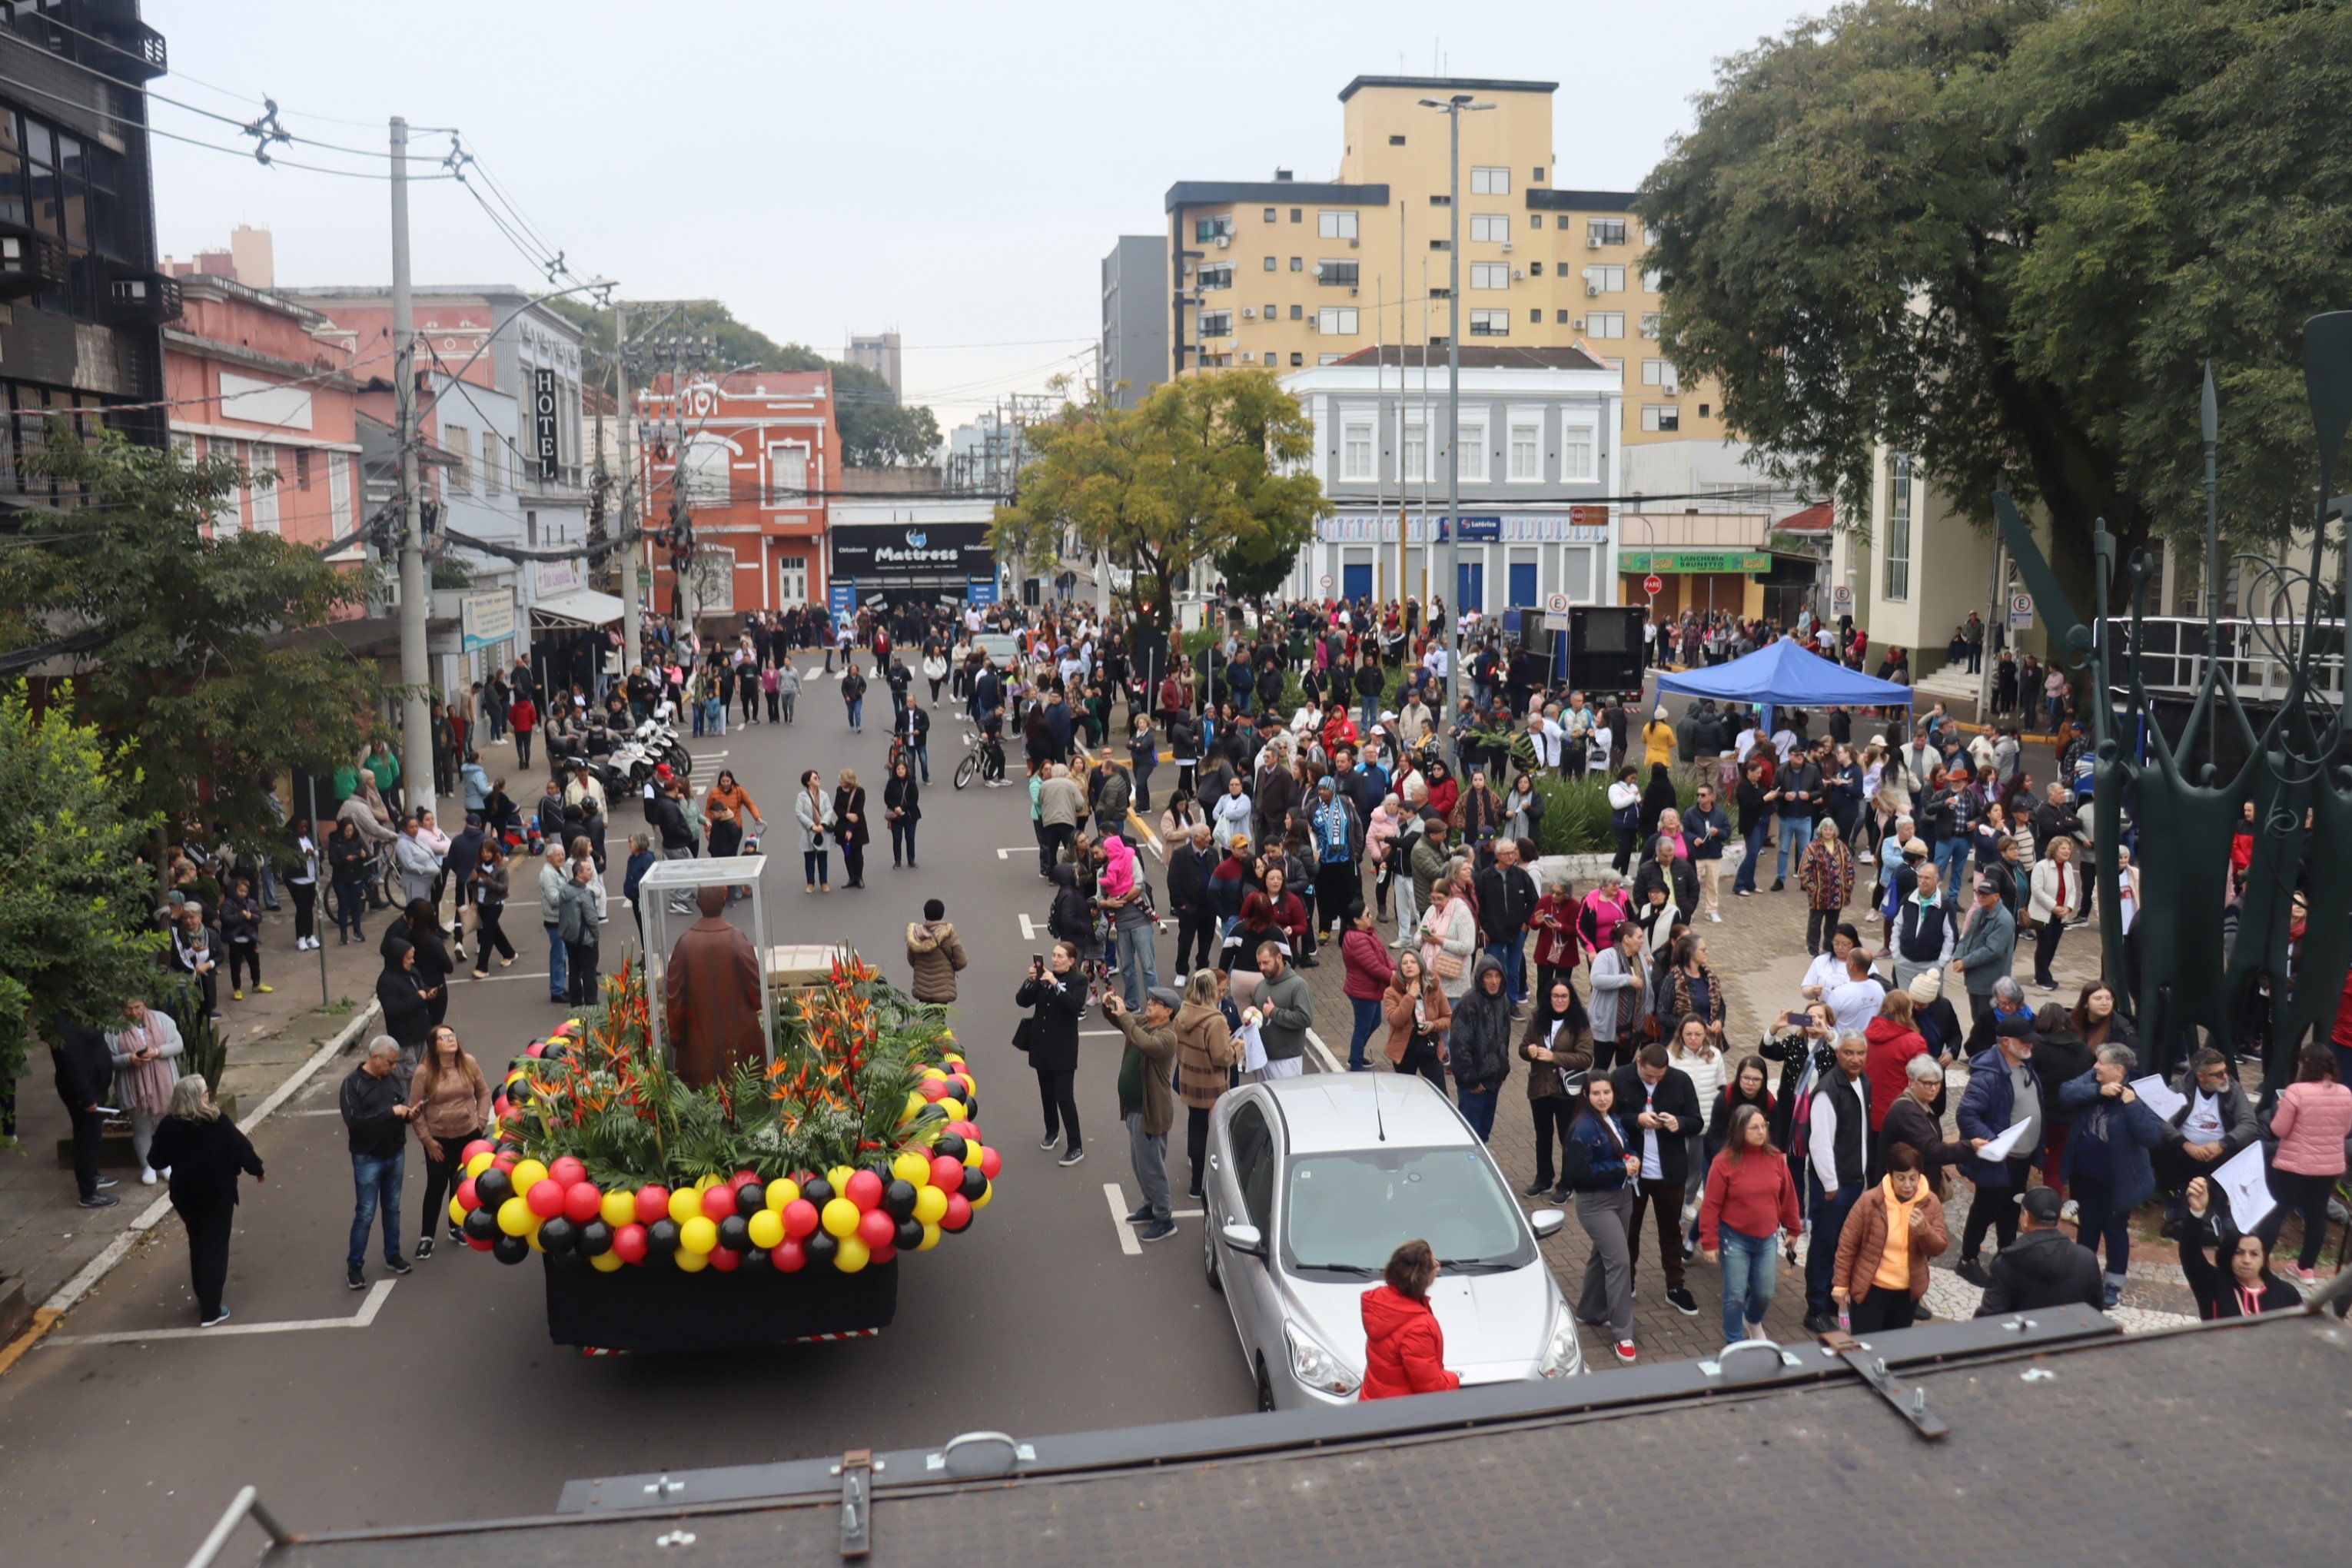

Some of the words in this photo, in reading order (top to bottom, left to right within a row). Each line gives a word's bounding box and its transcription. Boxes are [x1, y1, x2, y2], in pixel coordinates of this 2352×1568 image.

[538, 373, 554, 478] HOTEL
[875, 546, 958, 562] Mattress
[1839, 590, 1846, 598] E
[1554, 598, 1561, 609] E
[2018, 599, 2025, 609] E
